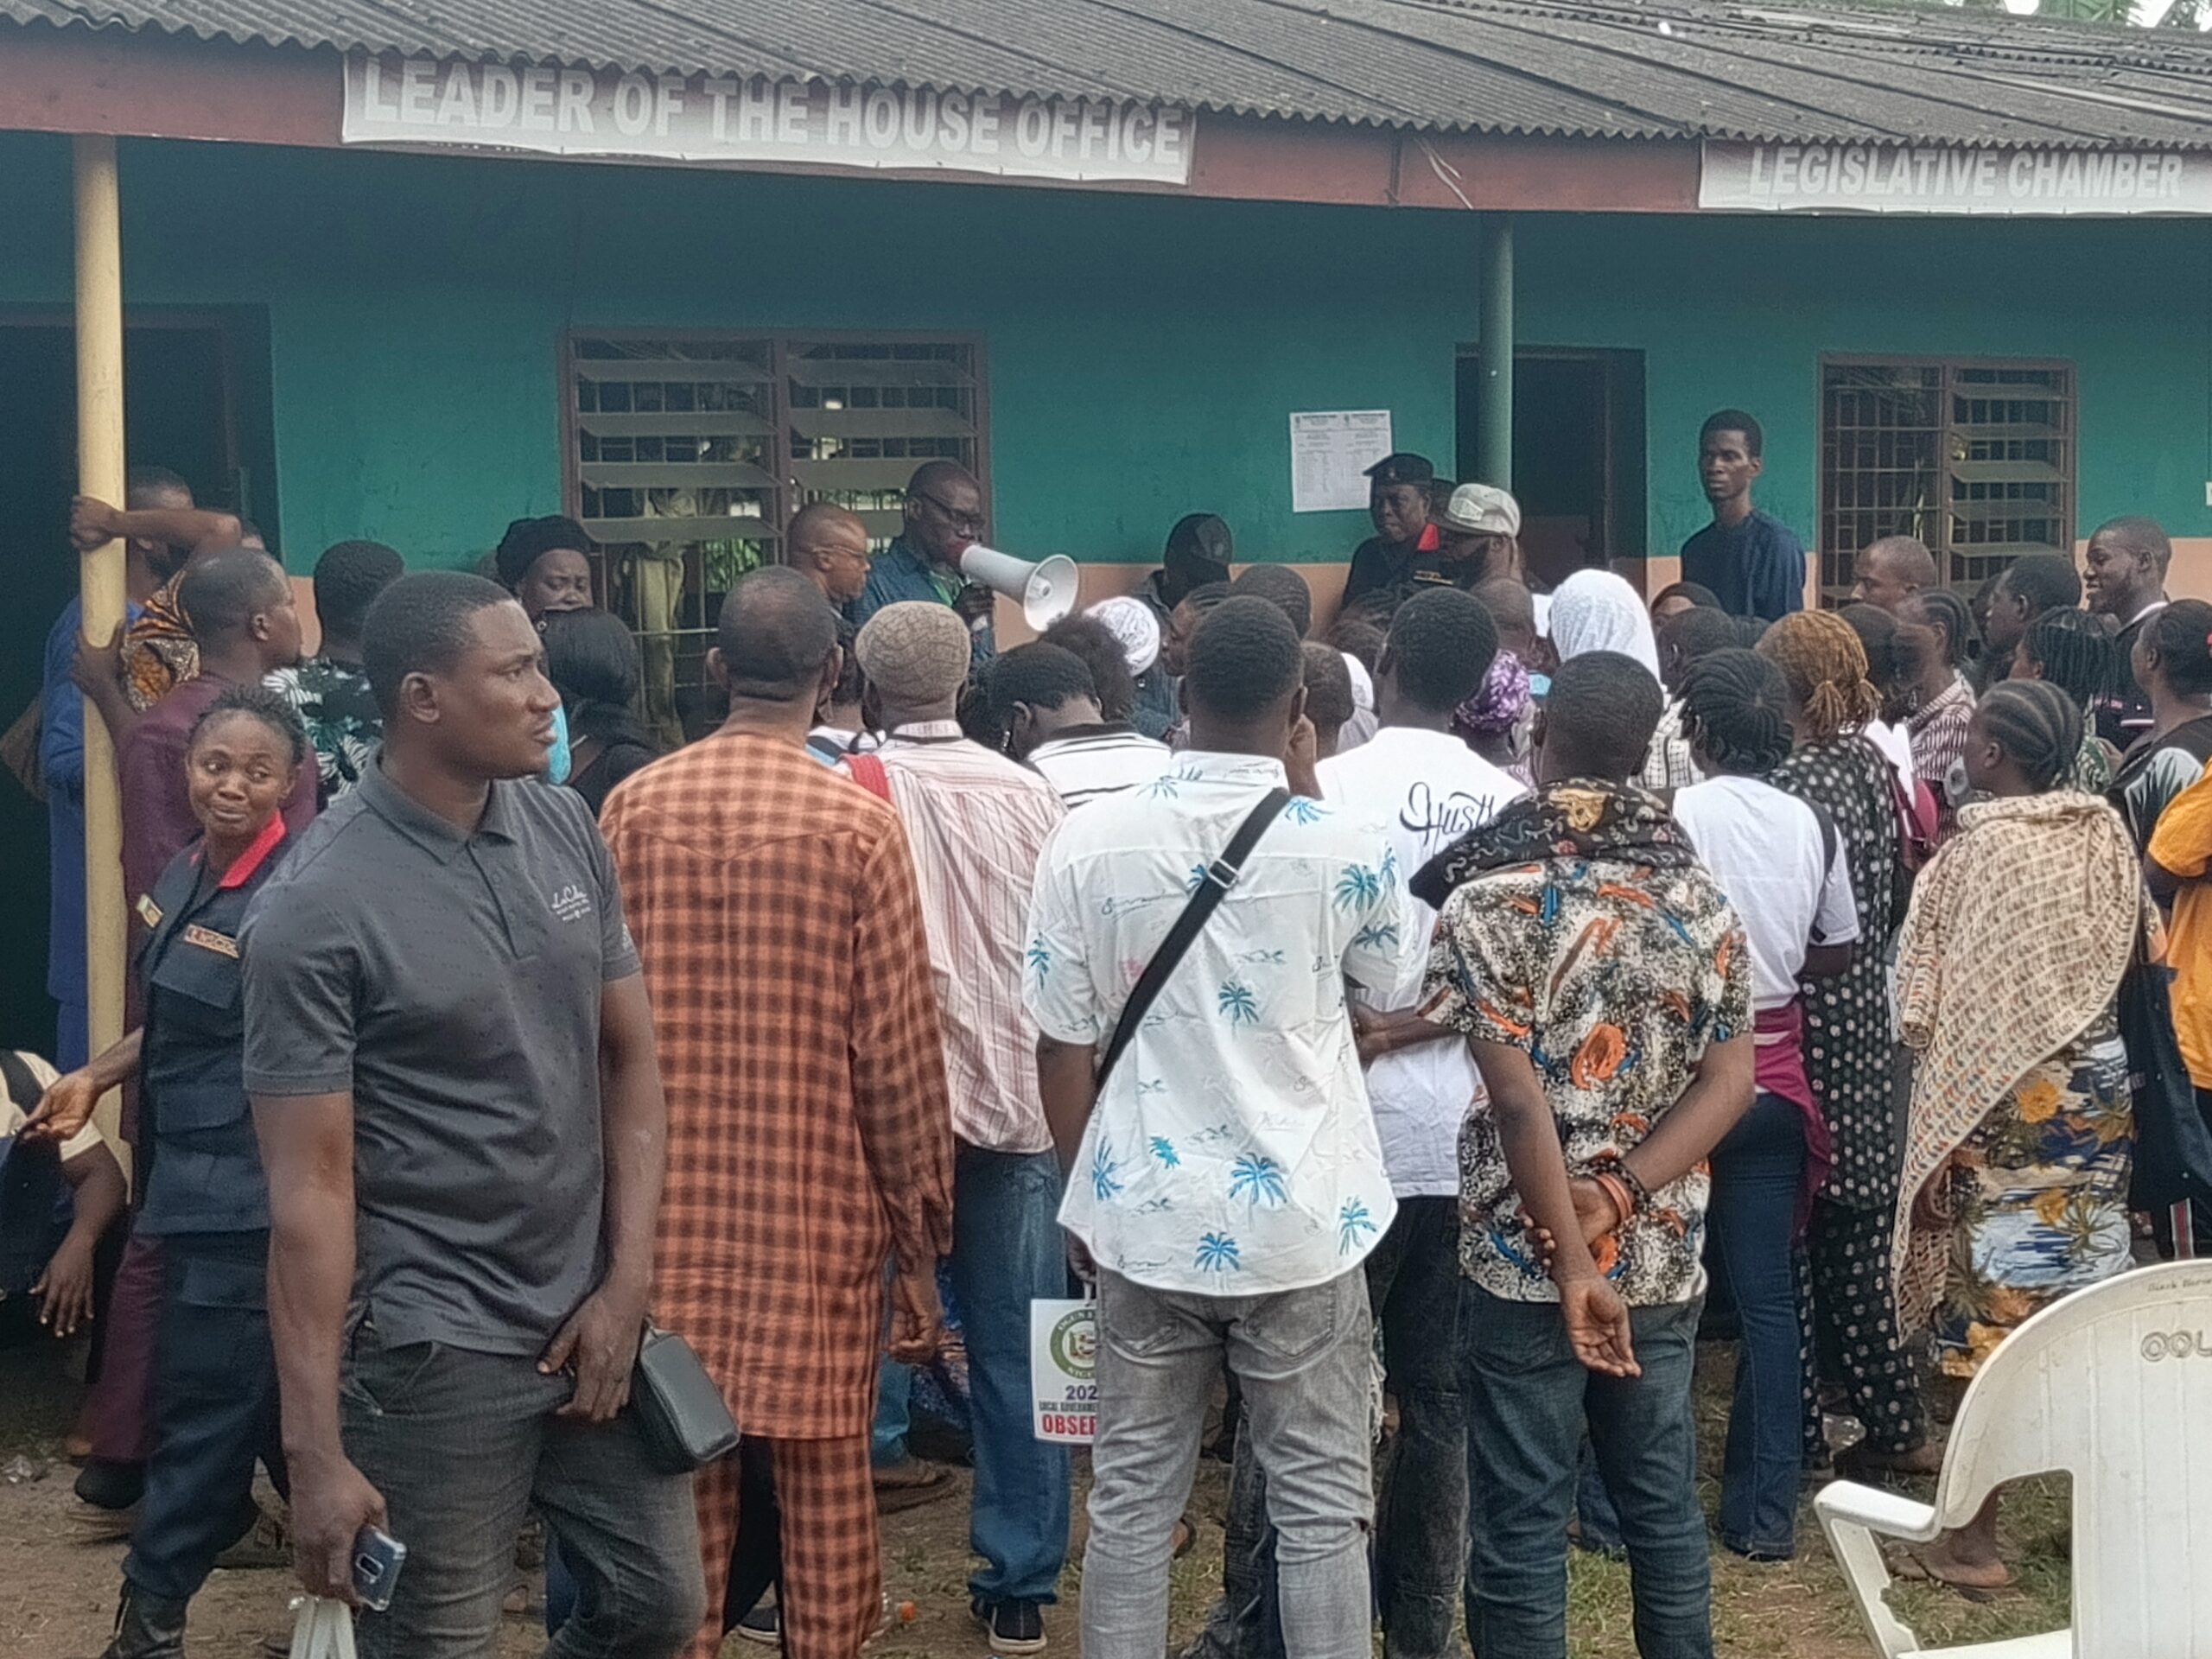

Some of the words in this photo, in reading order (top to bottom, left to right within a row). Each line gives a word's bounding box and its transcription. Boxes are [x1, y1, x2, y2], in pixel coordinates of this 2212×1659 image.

[364, 57, 595, 133] LEADER
[613, 72, 687, 138] OF
[704, 78, 810, 143] THE
[826, 85, 1001, 155] HOUSE
[1016, 99, 1183, 164] OFFICE
[1749, 145, 1998, 197] LEGISLATIVE
[2009, 151, 2183, 200] CHAMBER
